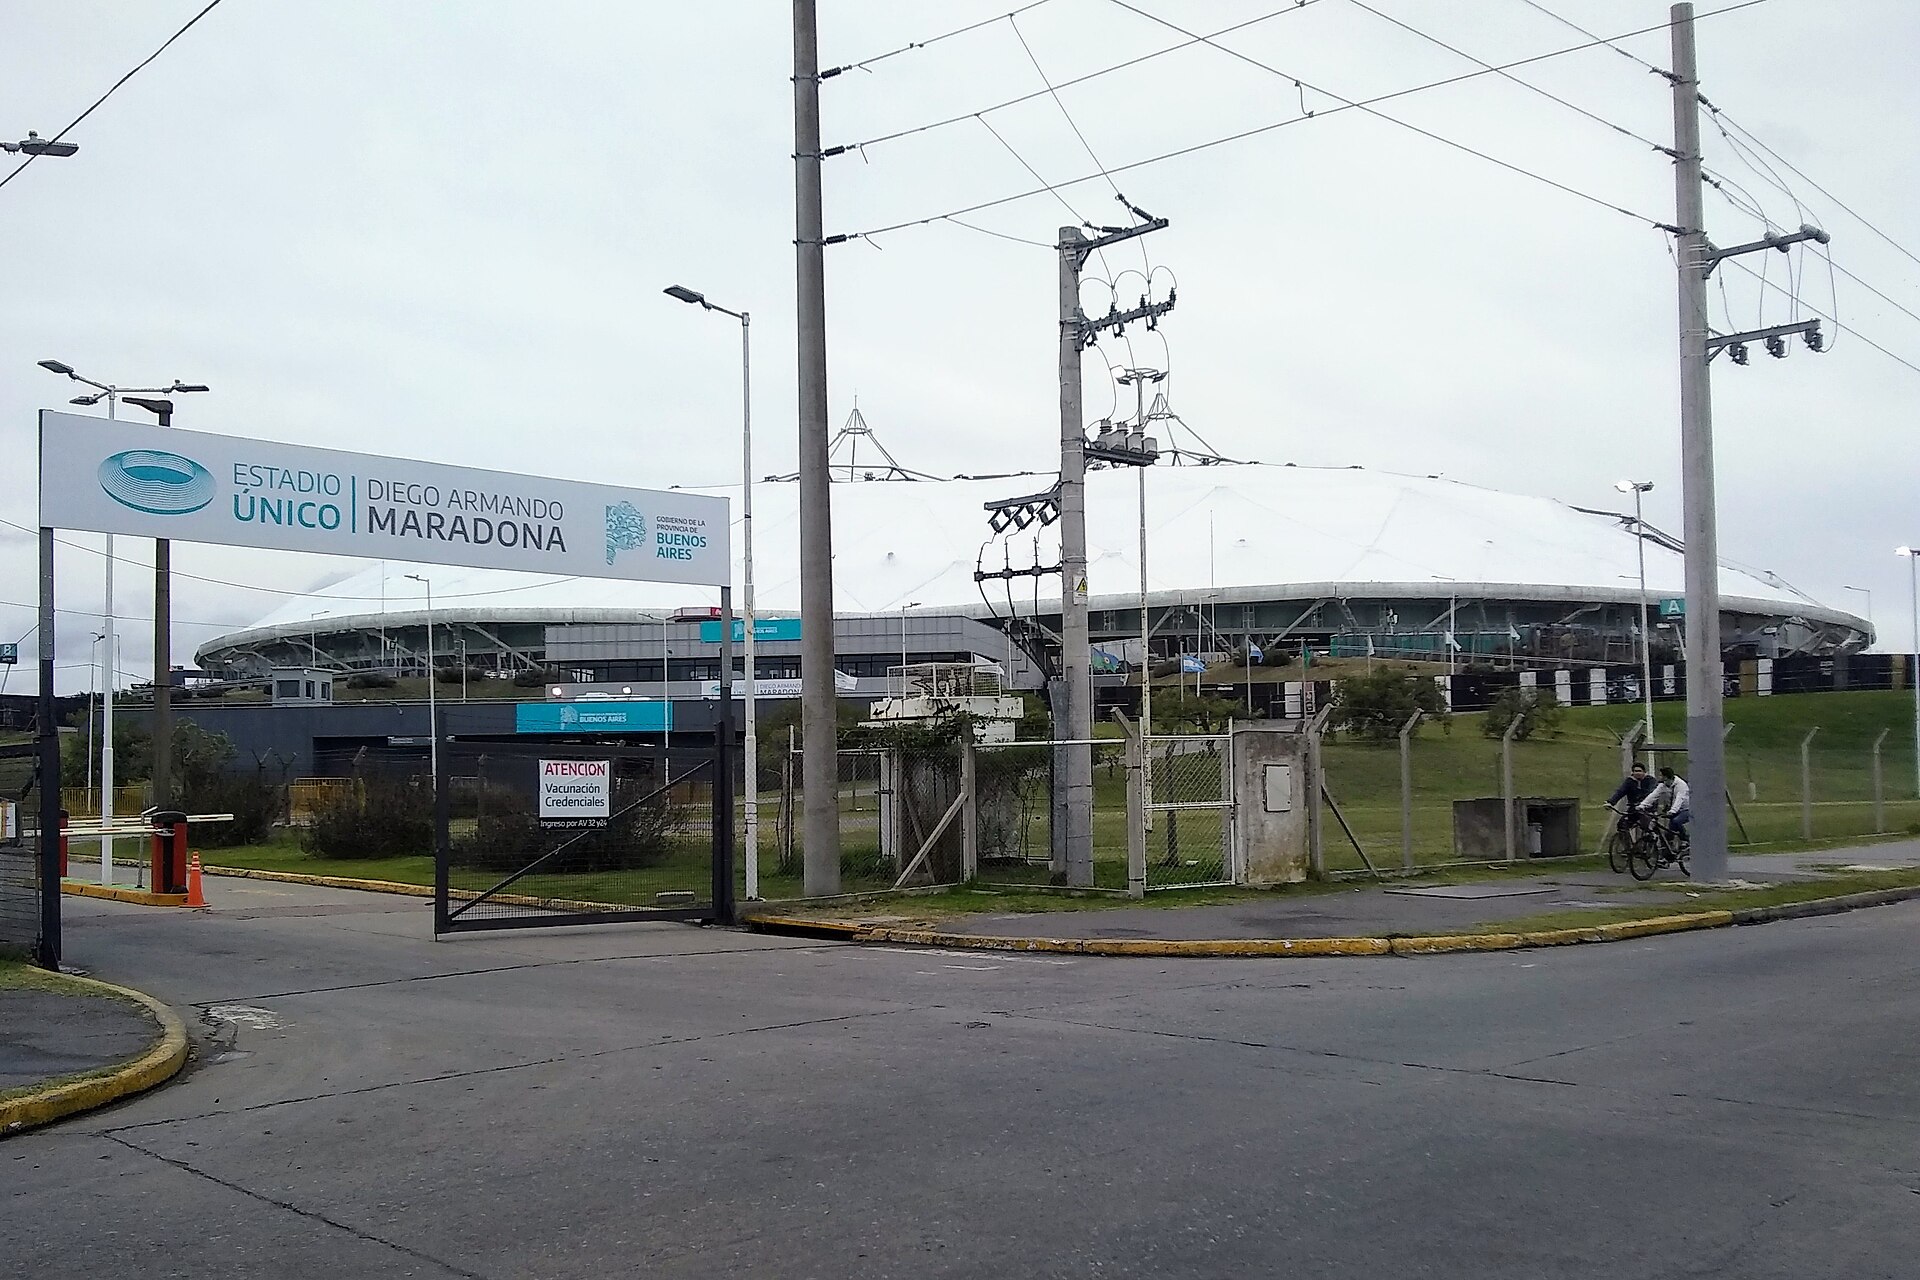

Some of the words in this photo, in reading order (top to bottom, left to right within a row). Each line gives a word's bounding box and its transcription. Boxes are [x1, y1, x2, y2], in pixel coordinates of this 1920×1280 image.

[233, 463, 341, 496] ESTADIO
[368, 479, 440, 506] DIEGO
[447, 489, 564, 521] ARMANDO
[233, 488, 341, 530] ÚNICO
[656, 515, 688, 525] GOBIERNO
[697, 519, 706, 527] LA
[368, 505, 567, 553] MARADONA
[656, 524, 689, 533] PROVINCIA
[689, 526, 698, 534] DE
[656, 532, 707, 548] BUENOS
[656, 546, 692, 560] AIRES
[1669, 600, 1680, 613] A
[607, 715, 627, 723] AIRES
[544, 763, 606, 776] ATENCION
[545, 782, 601, 794] Vacunación
[545, 795, 605, 807] Credenciales
[540, 820, 566, 829] Ingreso
[566, 821, 577, 829] por
[588, 819, 596, 827] 32
